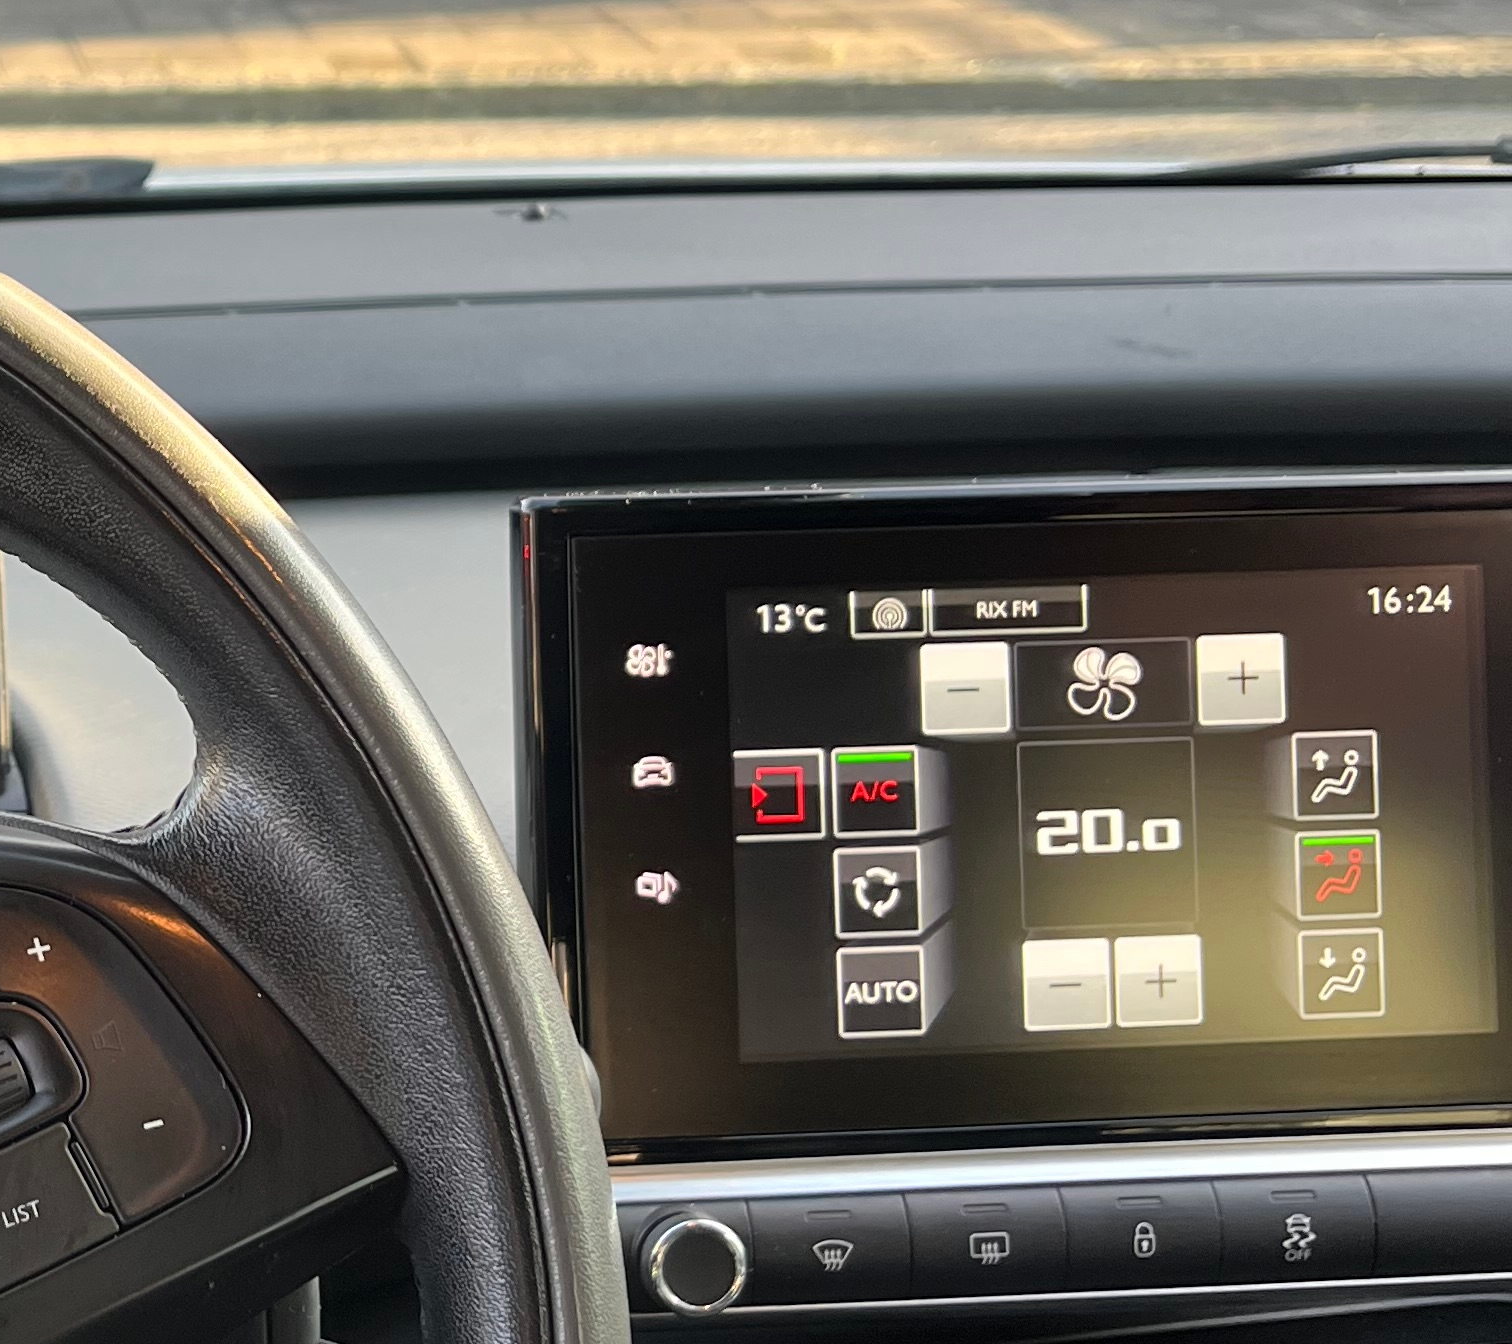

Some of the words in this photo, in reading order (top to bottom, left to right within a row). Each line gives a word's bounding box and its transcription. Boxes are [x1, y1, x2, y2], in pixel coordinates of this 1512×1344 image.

[975, 600, 1008, 619] RIX
[1012, 599, 1038, 618] FM
[1367, 584, 1452, 616] 16:24
[850, 778, 899, 805] A/C
[1034, 807, 1182, 857] 20.0
[844, 979, 918, 1007] AUTO
[0, 1198, 41, 1230] LIST
[1284, 1247, 1313, 1262] OFF
